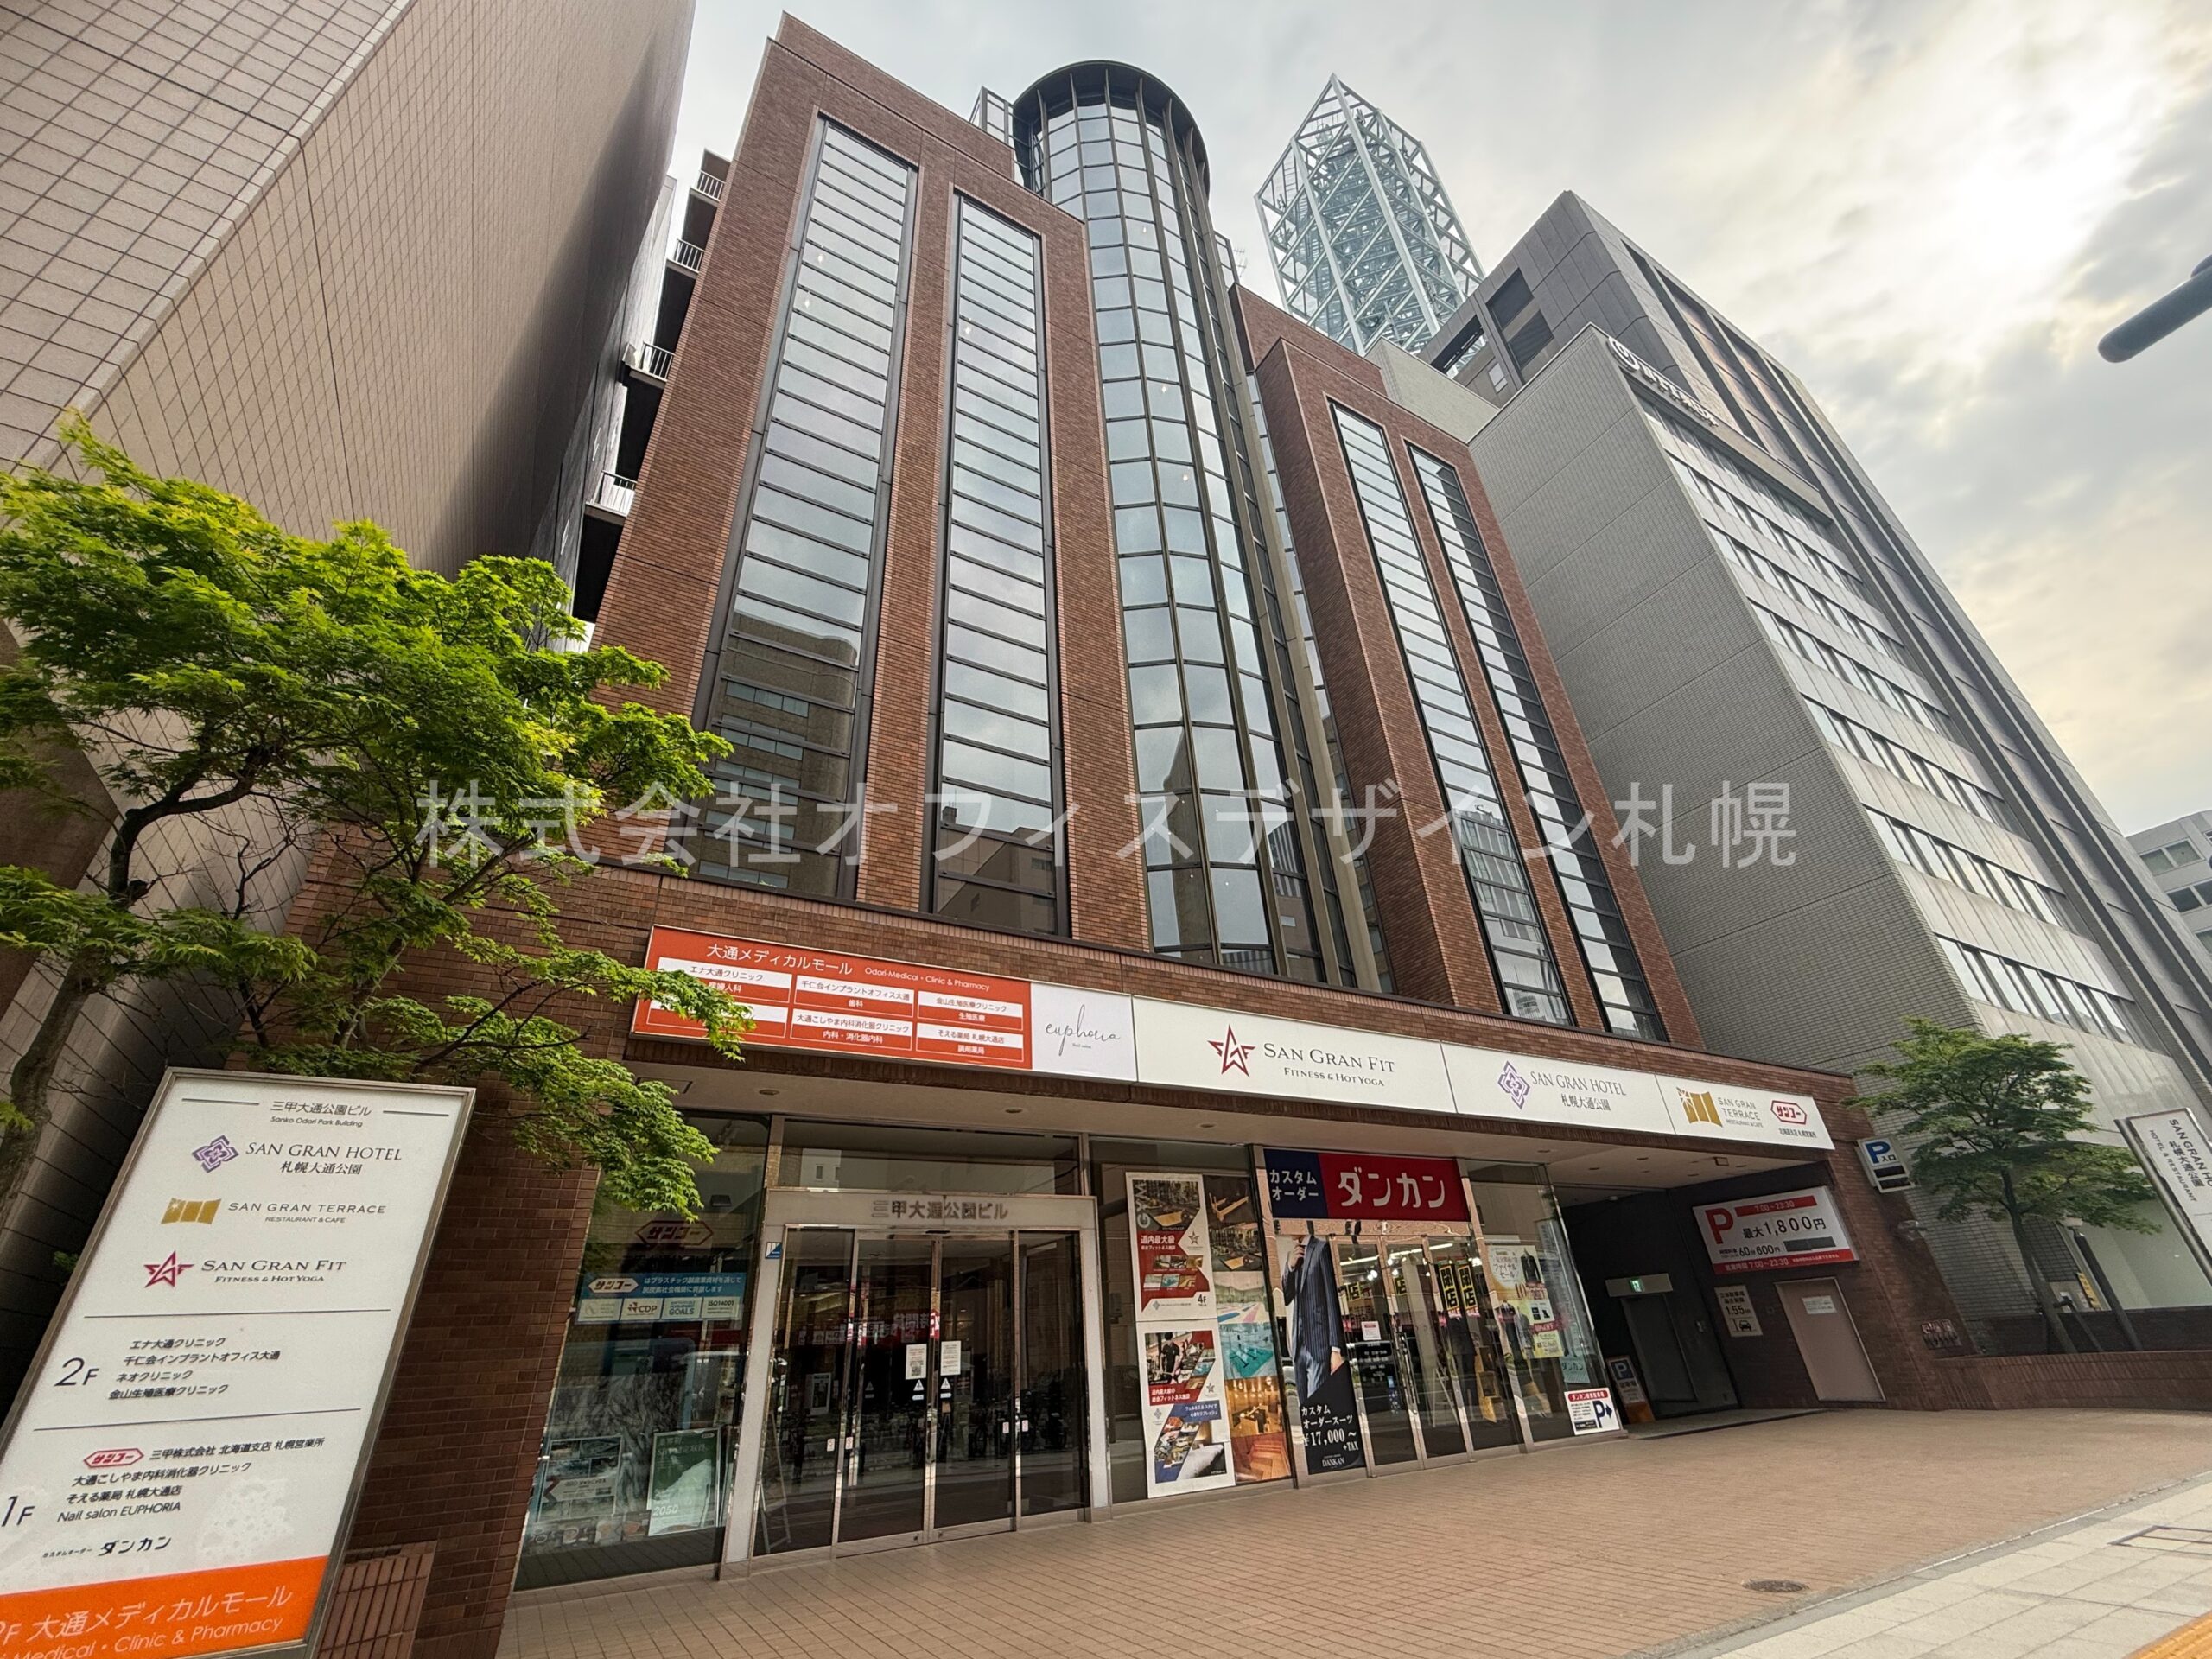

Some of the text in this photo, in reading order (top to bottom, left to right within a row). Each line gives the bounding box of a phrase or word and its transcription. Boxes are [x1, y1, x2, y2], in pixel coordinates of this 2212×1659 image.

[706, 943, 853, 976] 大通メディカルモール
[865, 967, 919, 982] Odori-Medical
[925, 975, 945, 985] Clinic
[955, 979, 990, 992] Pharmacy
[1530, 1071, 1627, 1096] SAN GRAN HOTEL
[270, 1101, 372, 1116] 三甲大通公園ビル
[1561, 1093, 1611, 1111] 札幌大通公園
[1718, 1096, 1756, 1109] SAN GRAN
[1722, 1108, 1760, 1121] TERRACE
[1776, 1105, 1801, 1118] サンコー
[245, 1142, 402, 1160] SAN GRAN HOTEL
[1865, 1141, 1891, 1164] P
[2170, 1118, 2188, 1140] SAN
[2183, 1141, 2206, 1170] GRAN
[281, 1160, 363, 1175] 札幌大通公園
[2149, 1129, 2164, 1151] HOTEL
[2167, 1156, 2197, 1202] RESTAURANT
[1269, 1169, 1317, 1185] カスタム
[1272, 1186, 1319, 1201] オーダー
[1338, 1166, 1446, 1208] ダンカン
[228, 1202, 386, 1214] SAN GRAN TERRACE
[871, 1199, 1008, 1220] 三甲大通公園ビル
[1705, 1206, 1733, 1244] P
[594, 1281, 632, 1290] サンコー
[669, 1307, 695, 1316] GOALS
[130, 1338, 226, 1350] エナ大通クリニック
[123, 1350, 281, 1366] 千仁会インプラントオフィス大通
[54, 1357, 99, 1387] 2F
[116, 1370, 193, 1382] ネオクリニック
[1615, 1362, 1628, 1378] P
[108, 1383, 228, 1400] 金山生殖医療クリニック
[1301, 1404, 1331, 1417] カスタム
[1592, 1400, 1606, 1428] P
[1303, 1414, 1353, 1429] オーダースーツ
[149, 1437, 325, 1460] 三甲株式会社 北海道支店 札幌営業所
[92, 1452, 135, 1465] サンコー
[72, 1462, 252, 1488] 大通こしやま内科消化器クリニック
[67, 1484, 183, 1504] そえる薬局 札幌大通店
[1, 1495, 35, 1528] 1F
[57, 1502, 181, 1522] Nail salon EUPHORIA
[652, 1505, 678, 1516] 2050
[98, 1536, 172, 1556] ダンカン
[26, 1585, 293, 1642] 大通メディカルモール
[114, 1631, 166, 1653] Clinic
[172, 1629, 184, 1643] &
[190, 1617, 284, 1642] Pharmacy
